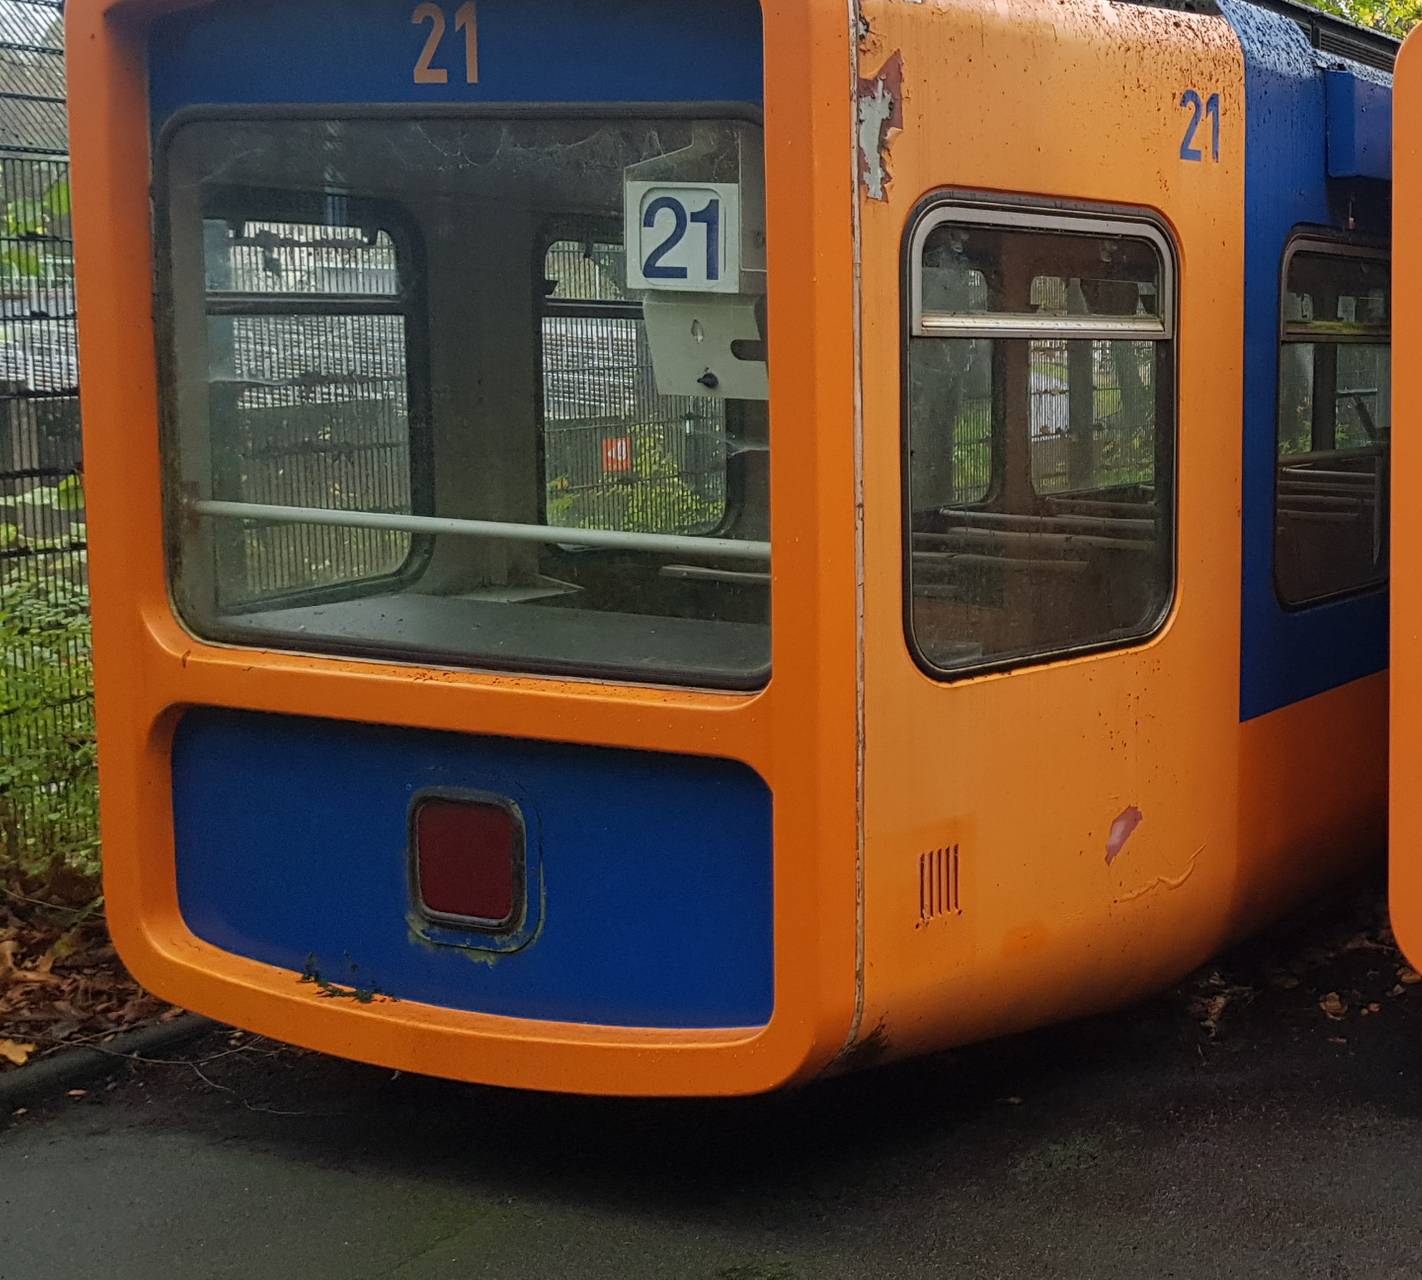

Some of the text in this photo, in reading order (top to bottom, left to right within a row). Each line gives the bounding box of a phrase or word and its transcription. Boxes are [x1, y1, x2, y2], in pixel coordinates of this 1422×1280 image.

[411, 0, 479, 84] 21
[1179, 89, 1220, 162] 21
[642, 196, 720, 281] 21
